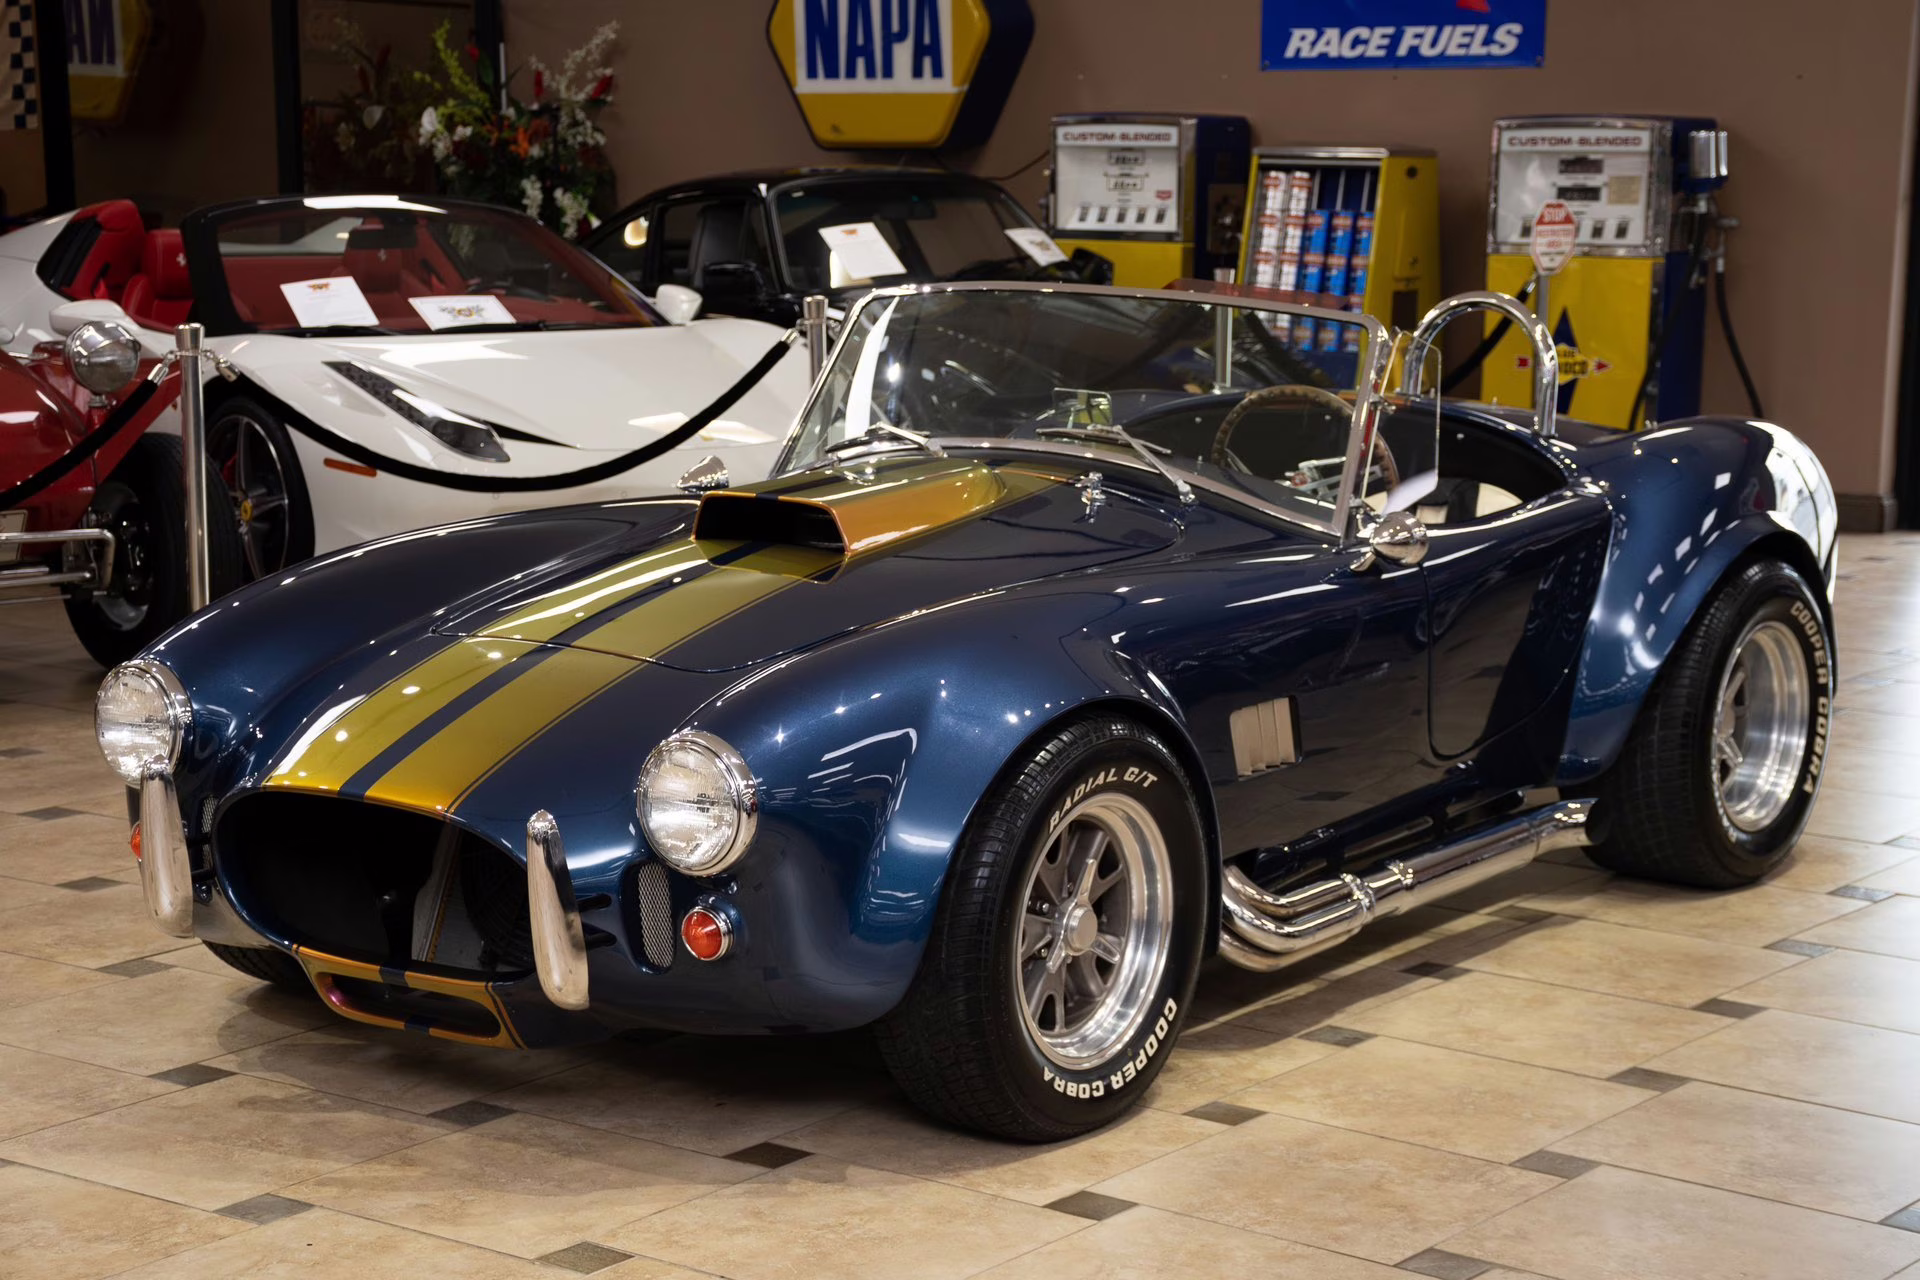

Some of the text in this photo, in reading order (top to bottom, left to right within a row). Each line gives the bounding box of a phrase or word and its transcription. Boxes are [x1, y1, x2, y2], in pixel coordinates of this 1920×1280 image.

[805, 0, 944, 79] NAPA
[1284, 23, 1523, 58] RACE FUELS
[1544, 207, 1567, 223] STOP
[1790, 600, 1829, 794] COOPER COBRA
[1050, 766, 1158, 832] RADIAL G/T
[1043, 998, 1177, 1098] COOPER COBRA
